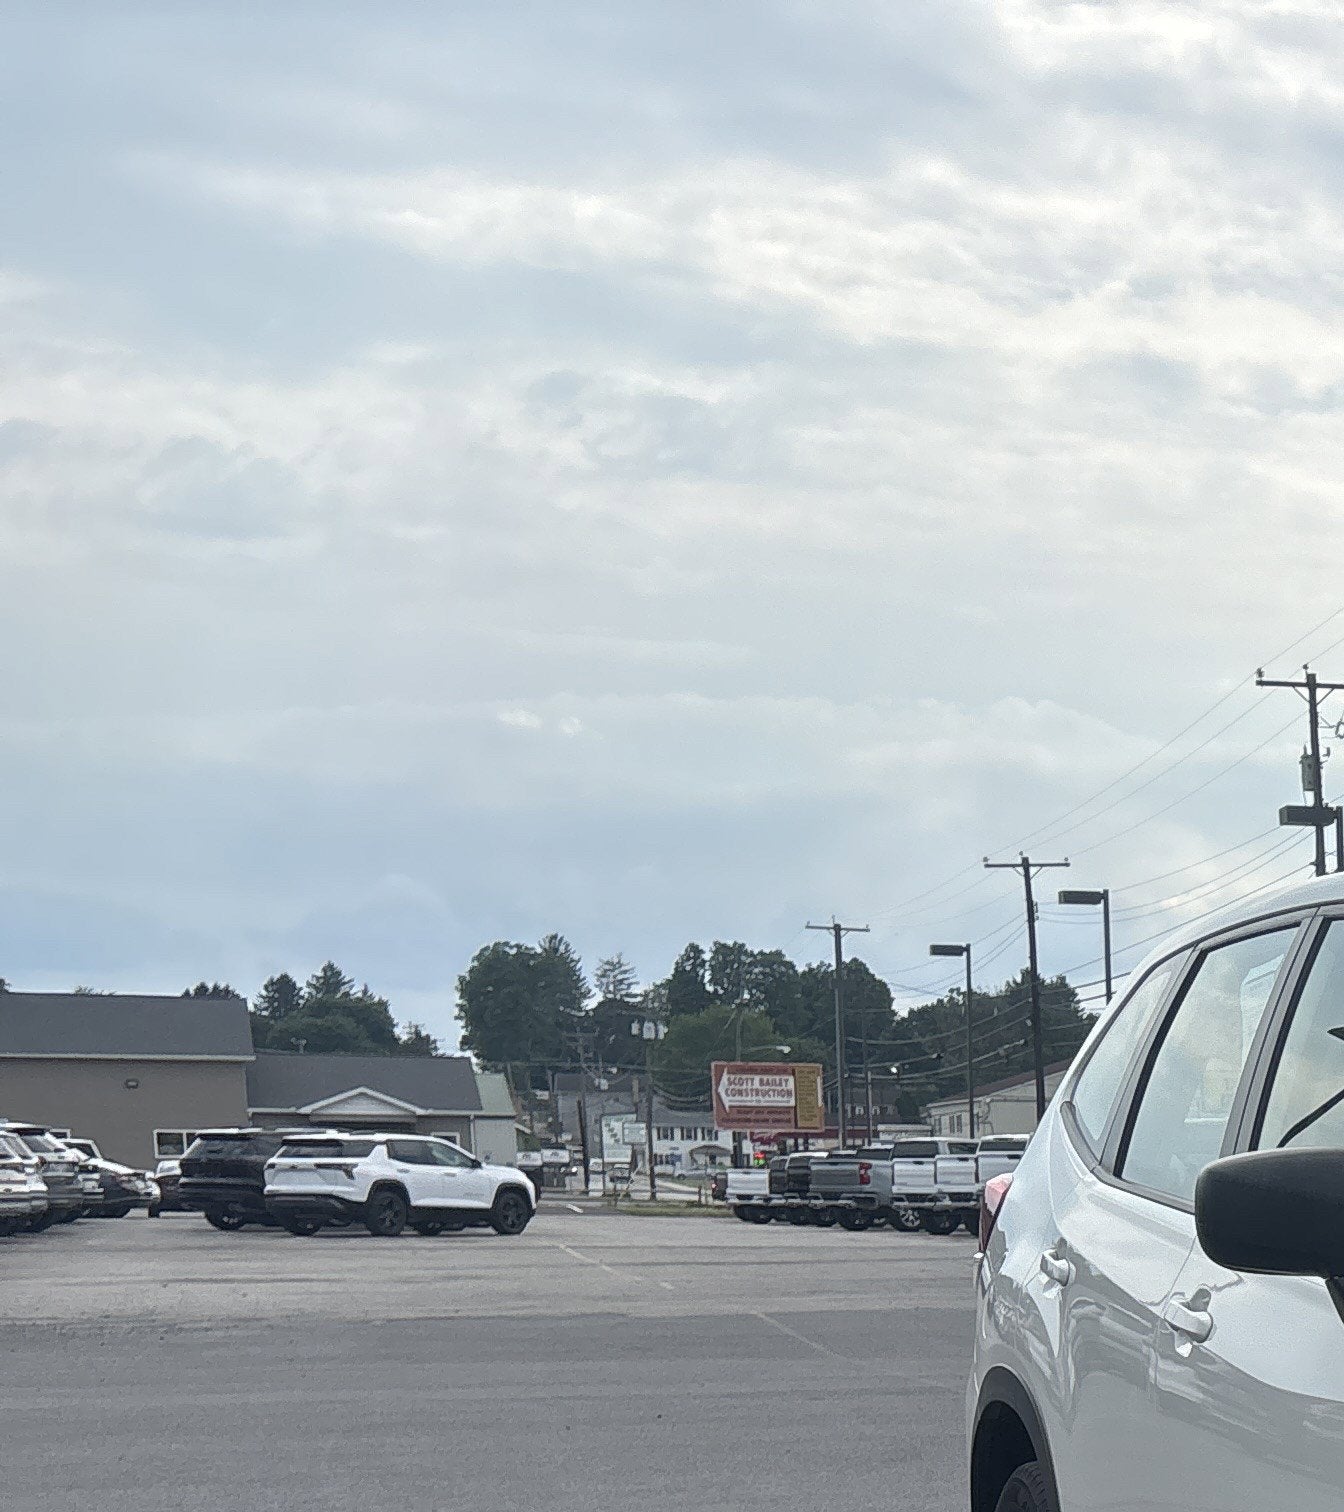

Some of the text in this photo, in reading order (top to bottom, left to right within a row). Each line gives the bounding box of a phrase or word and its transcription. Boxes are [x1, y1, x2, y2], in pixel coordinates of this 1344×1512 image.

[727, 1076, 790, 1087] SCOTT BAILEY
[724, 1088, 794, 1099] CONSTRUCTION
